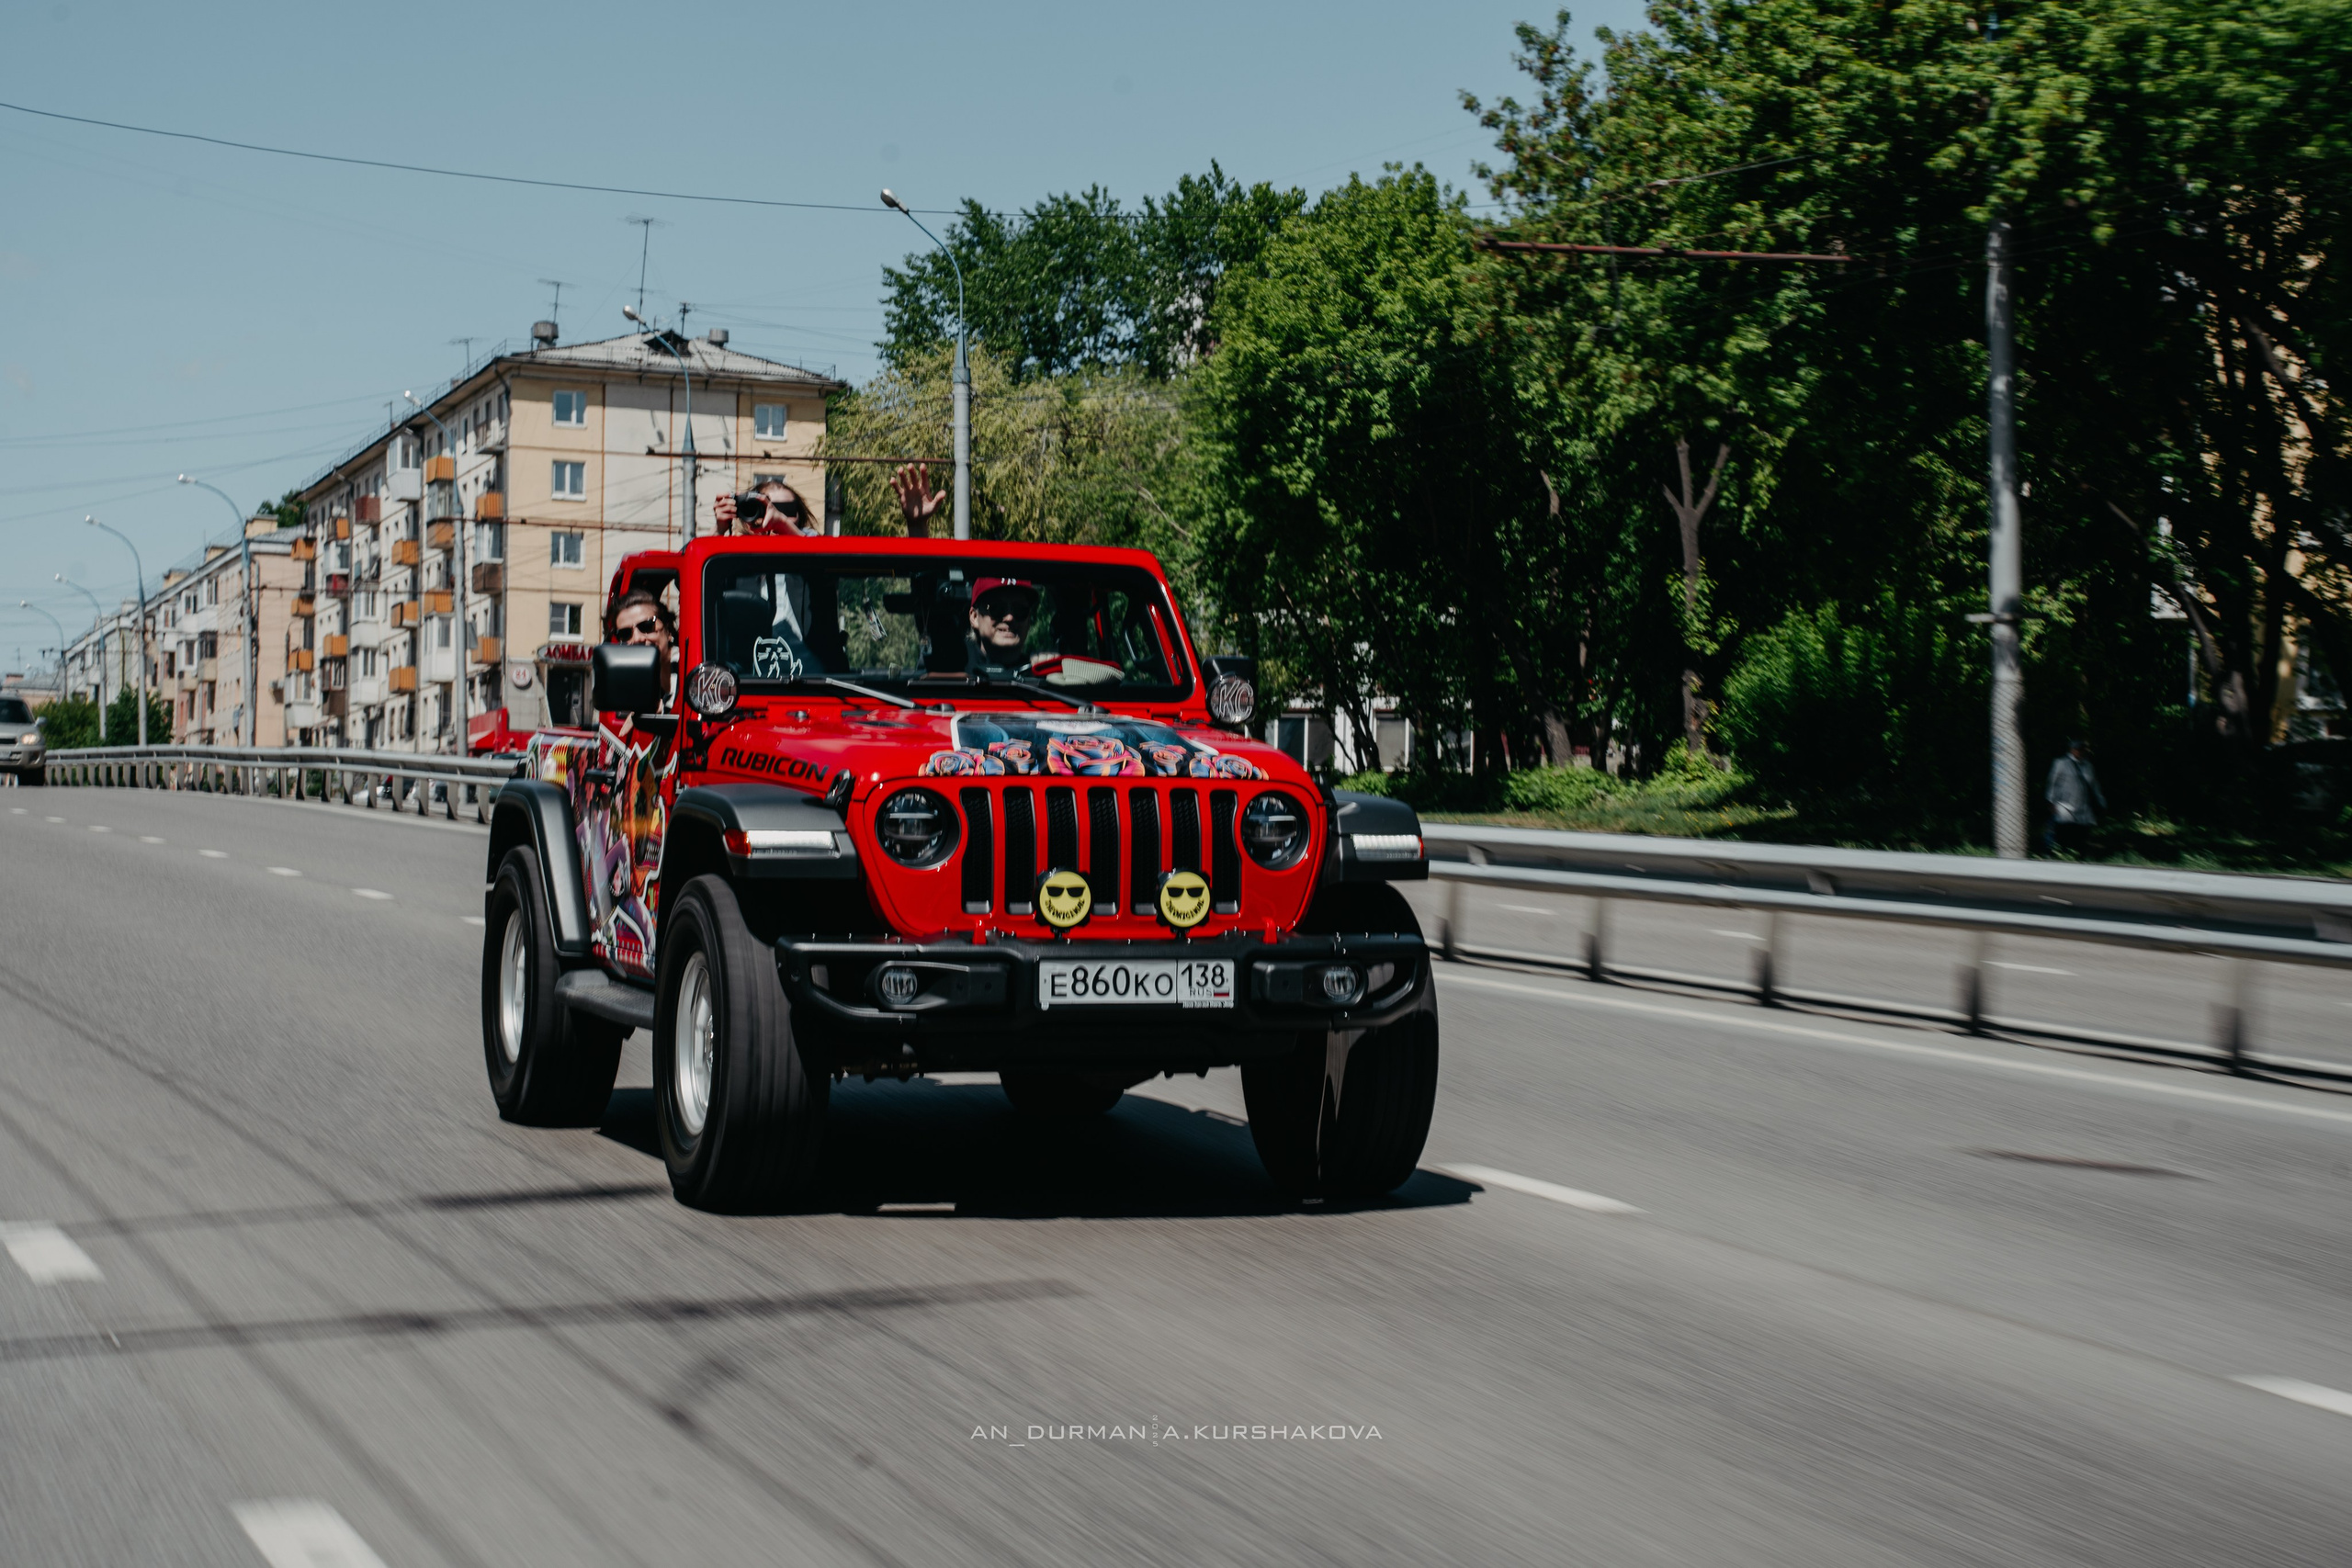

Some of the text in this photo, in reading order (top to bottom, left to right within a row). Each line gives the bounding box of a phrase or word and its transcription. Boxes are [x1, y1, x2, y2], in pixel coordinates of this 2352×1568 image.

[698, 670, 734, 708] KC
[1219, 680, 1253, 717] KC
[721, 747, 830, 782] RUBICON
[1181, 963, 1225, 987] 138
[1189, 987, 1212, 998] RUS
